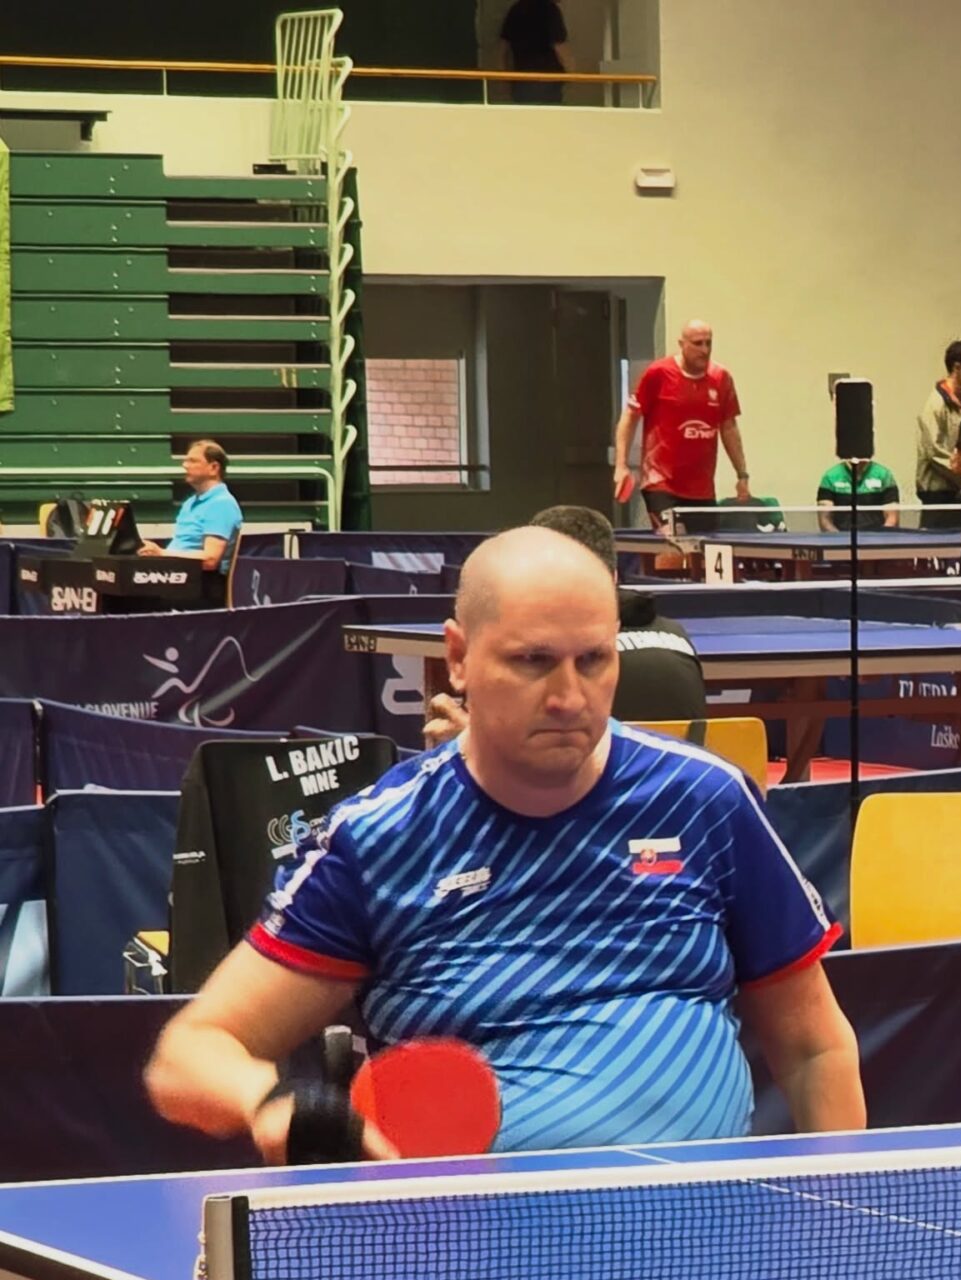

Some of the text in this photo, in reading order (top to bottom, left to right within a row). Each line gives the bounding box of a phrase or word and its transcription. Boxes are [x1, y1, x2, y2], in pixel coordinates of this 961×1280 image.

[714, 551, 724, 580] 4
[265, 754, 290, 782] L.
[300, 768, 340, 797] MNE
